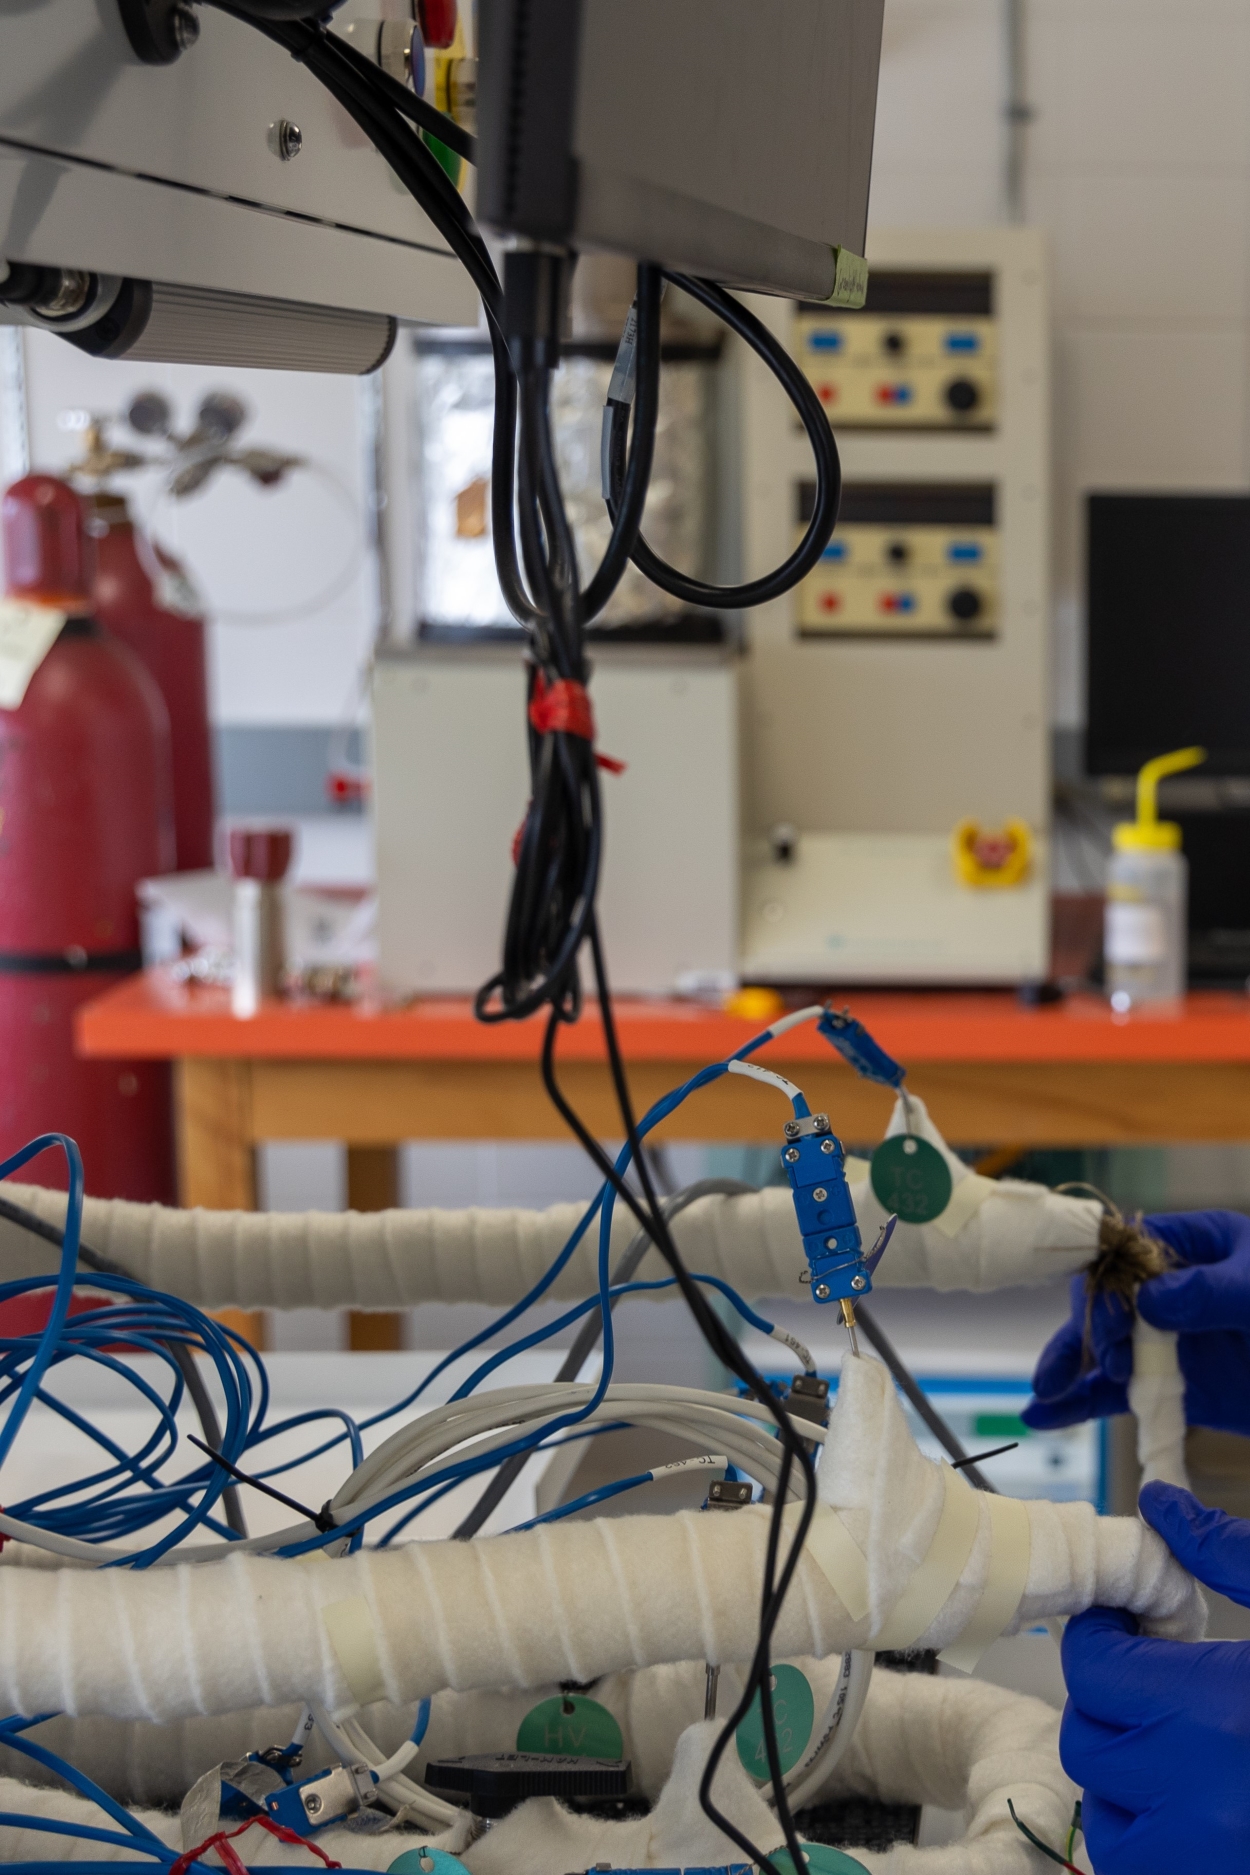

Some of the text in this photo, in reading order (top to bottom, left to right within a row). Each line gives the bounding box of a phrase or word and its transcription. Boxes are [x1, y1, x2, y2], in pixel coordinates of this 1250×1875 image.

[889, 1166, 923, 1190] TC
[545, 1725, 588, 1748] HV
[755, 1728, 793, 1763] 42
